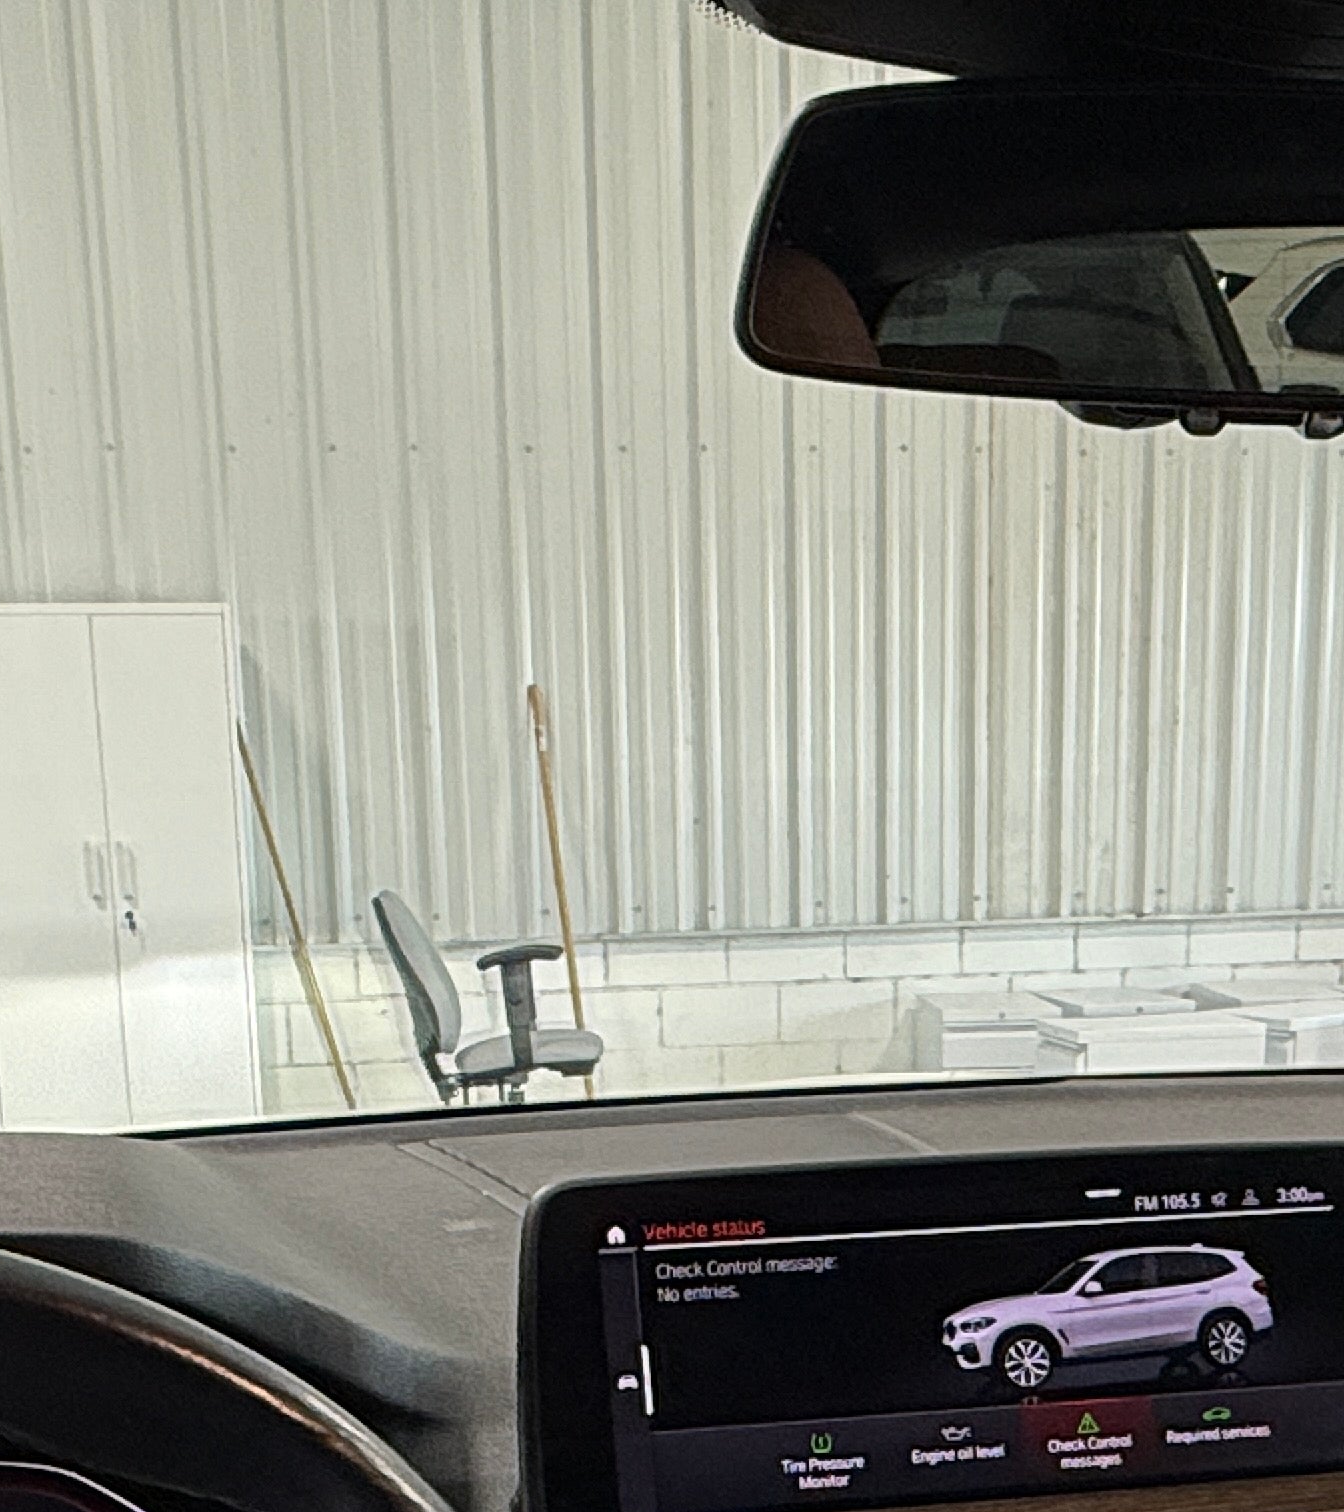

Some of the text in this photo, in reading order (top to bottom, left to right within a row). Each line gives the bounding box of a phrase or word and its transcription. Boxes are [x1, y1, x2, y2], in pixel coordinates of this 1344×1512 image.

[1134, 1192, 1200, 1211] FM 105.5
[641, 1219, 766, 1240] Vehicle status
[656, 1262, 704, 1280] Check
[707, 1257, 762, 1277] Control
[657, 1283, 740, 1302] No entries.
[1047, 1433, 1134, 1454] Check Control
[1166, 1424, 1271, 1446] Required services
[781, 1456, 865, 1473] Tire Pressure
[912, 1442, 1006, 1466] Engine oil level
[799, 1474, 851, 1490] Monitor
